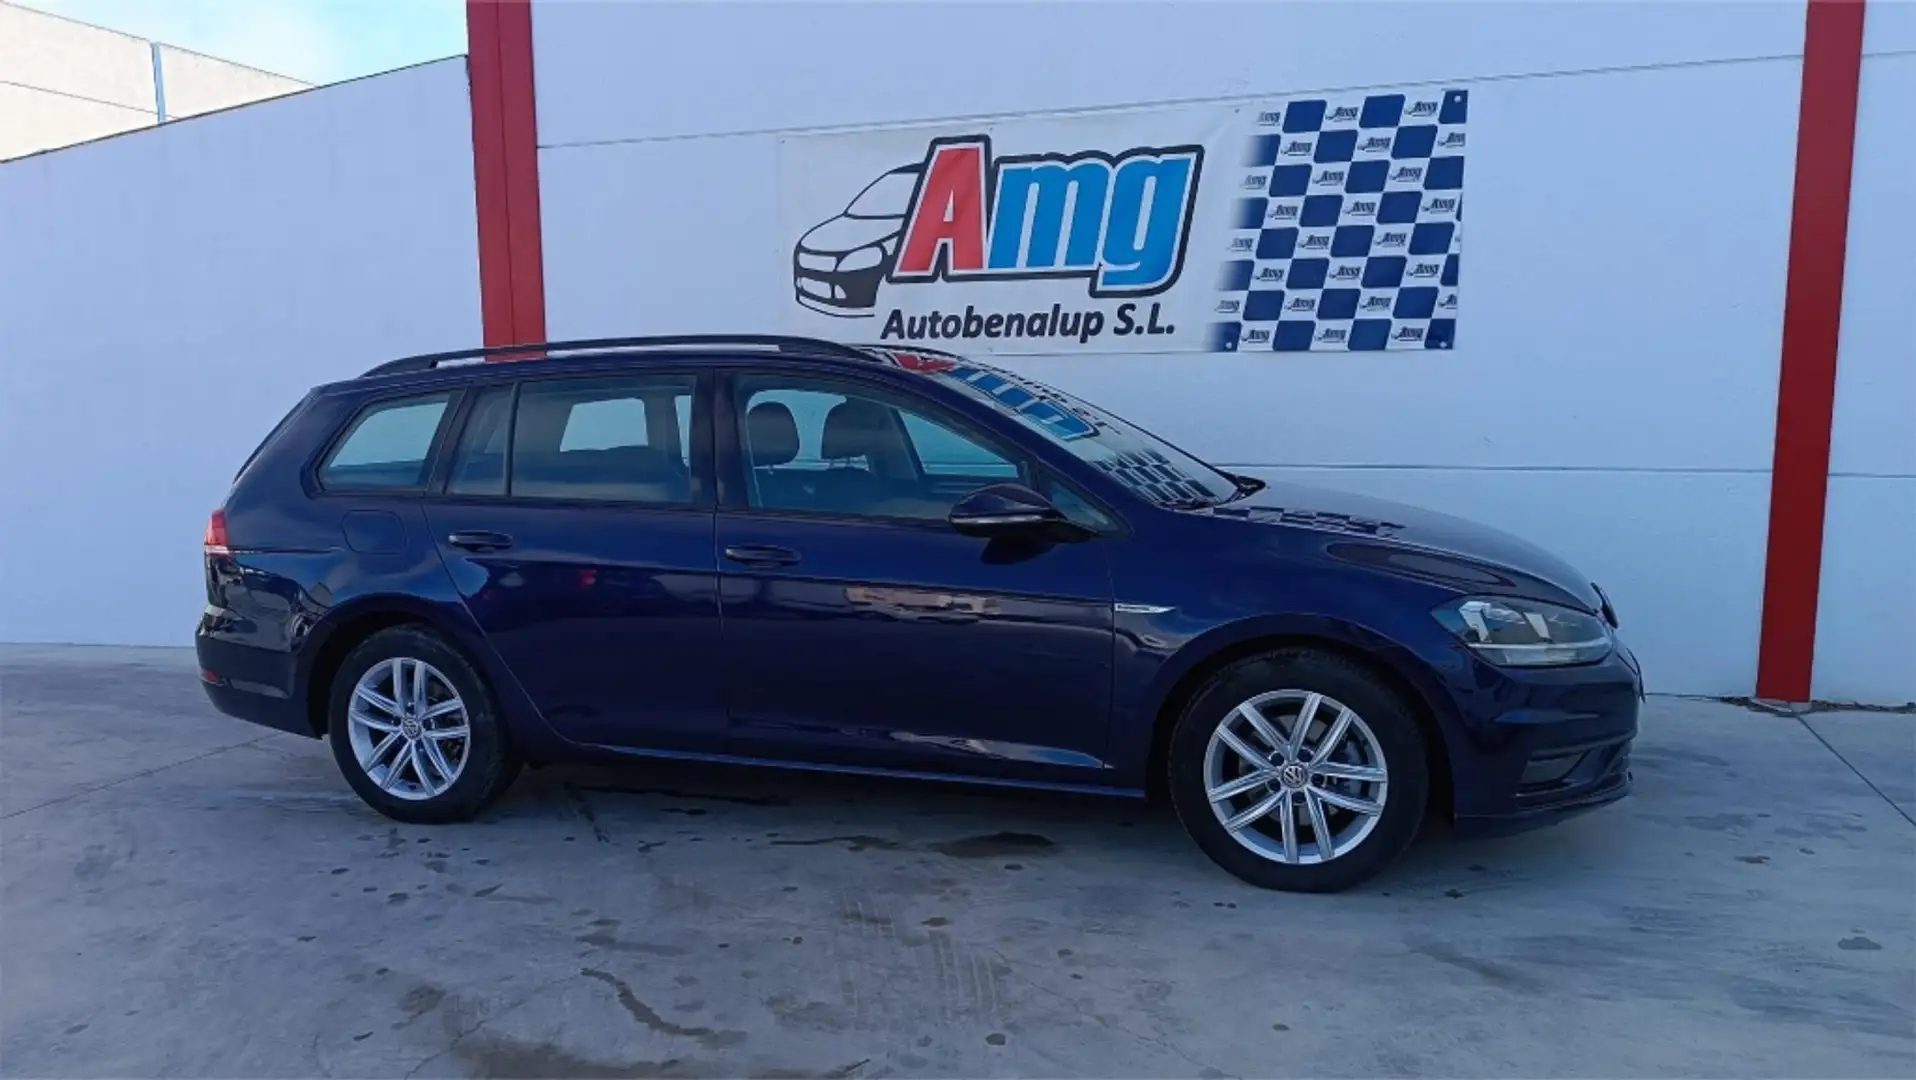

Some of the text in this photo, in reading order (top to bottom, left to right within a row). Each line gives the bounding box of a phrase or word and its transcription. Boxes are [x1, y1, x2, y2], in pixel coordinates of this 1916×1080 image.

[890, 138, 1202, 295] Amg
[880, 303, 1175, 343] Autobenalup S.L.
